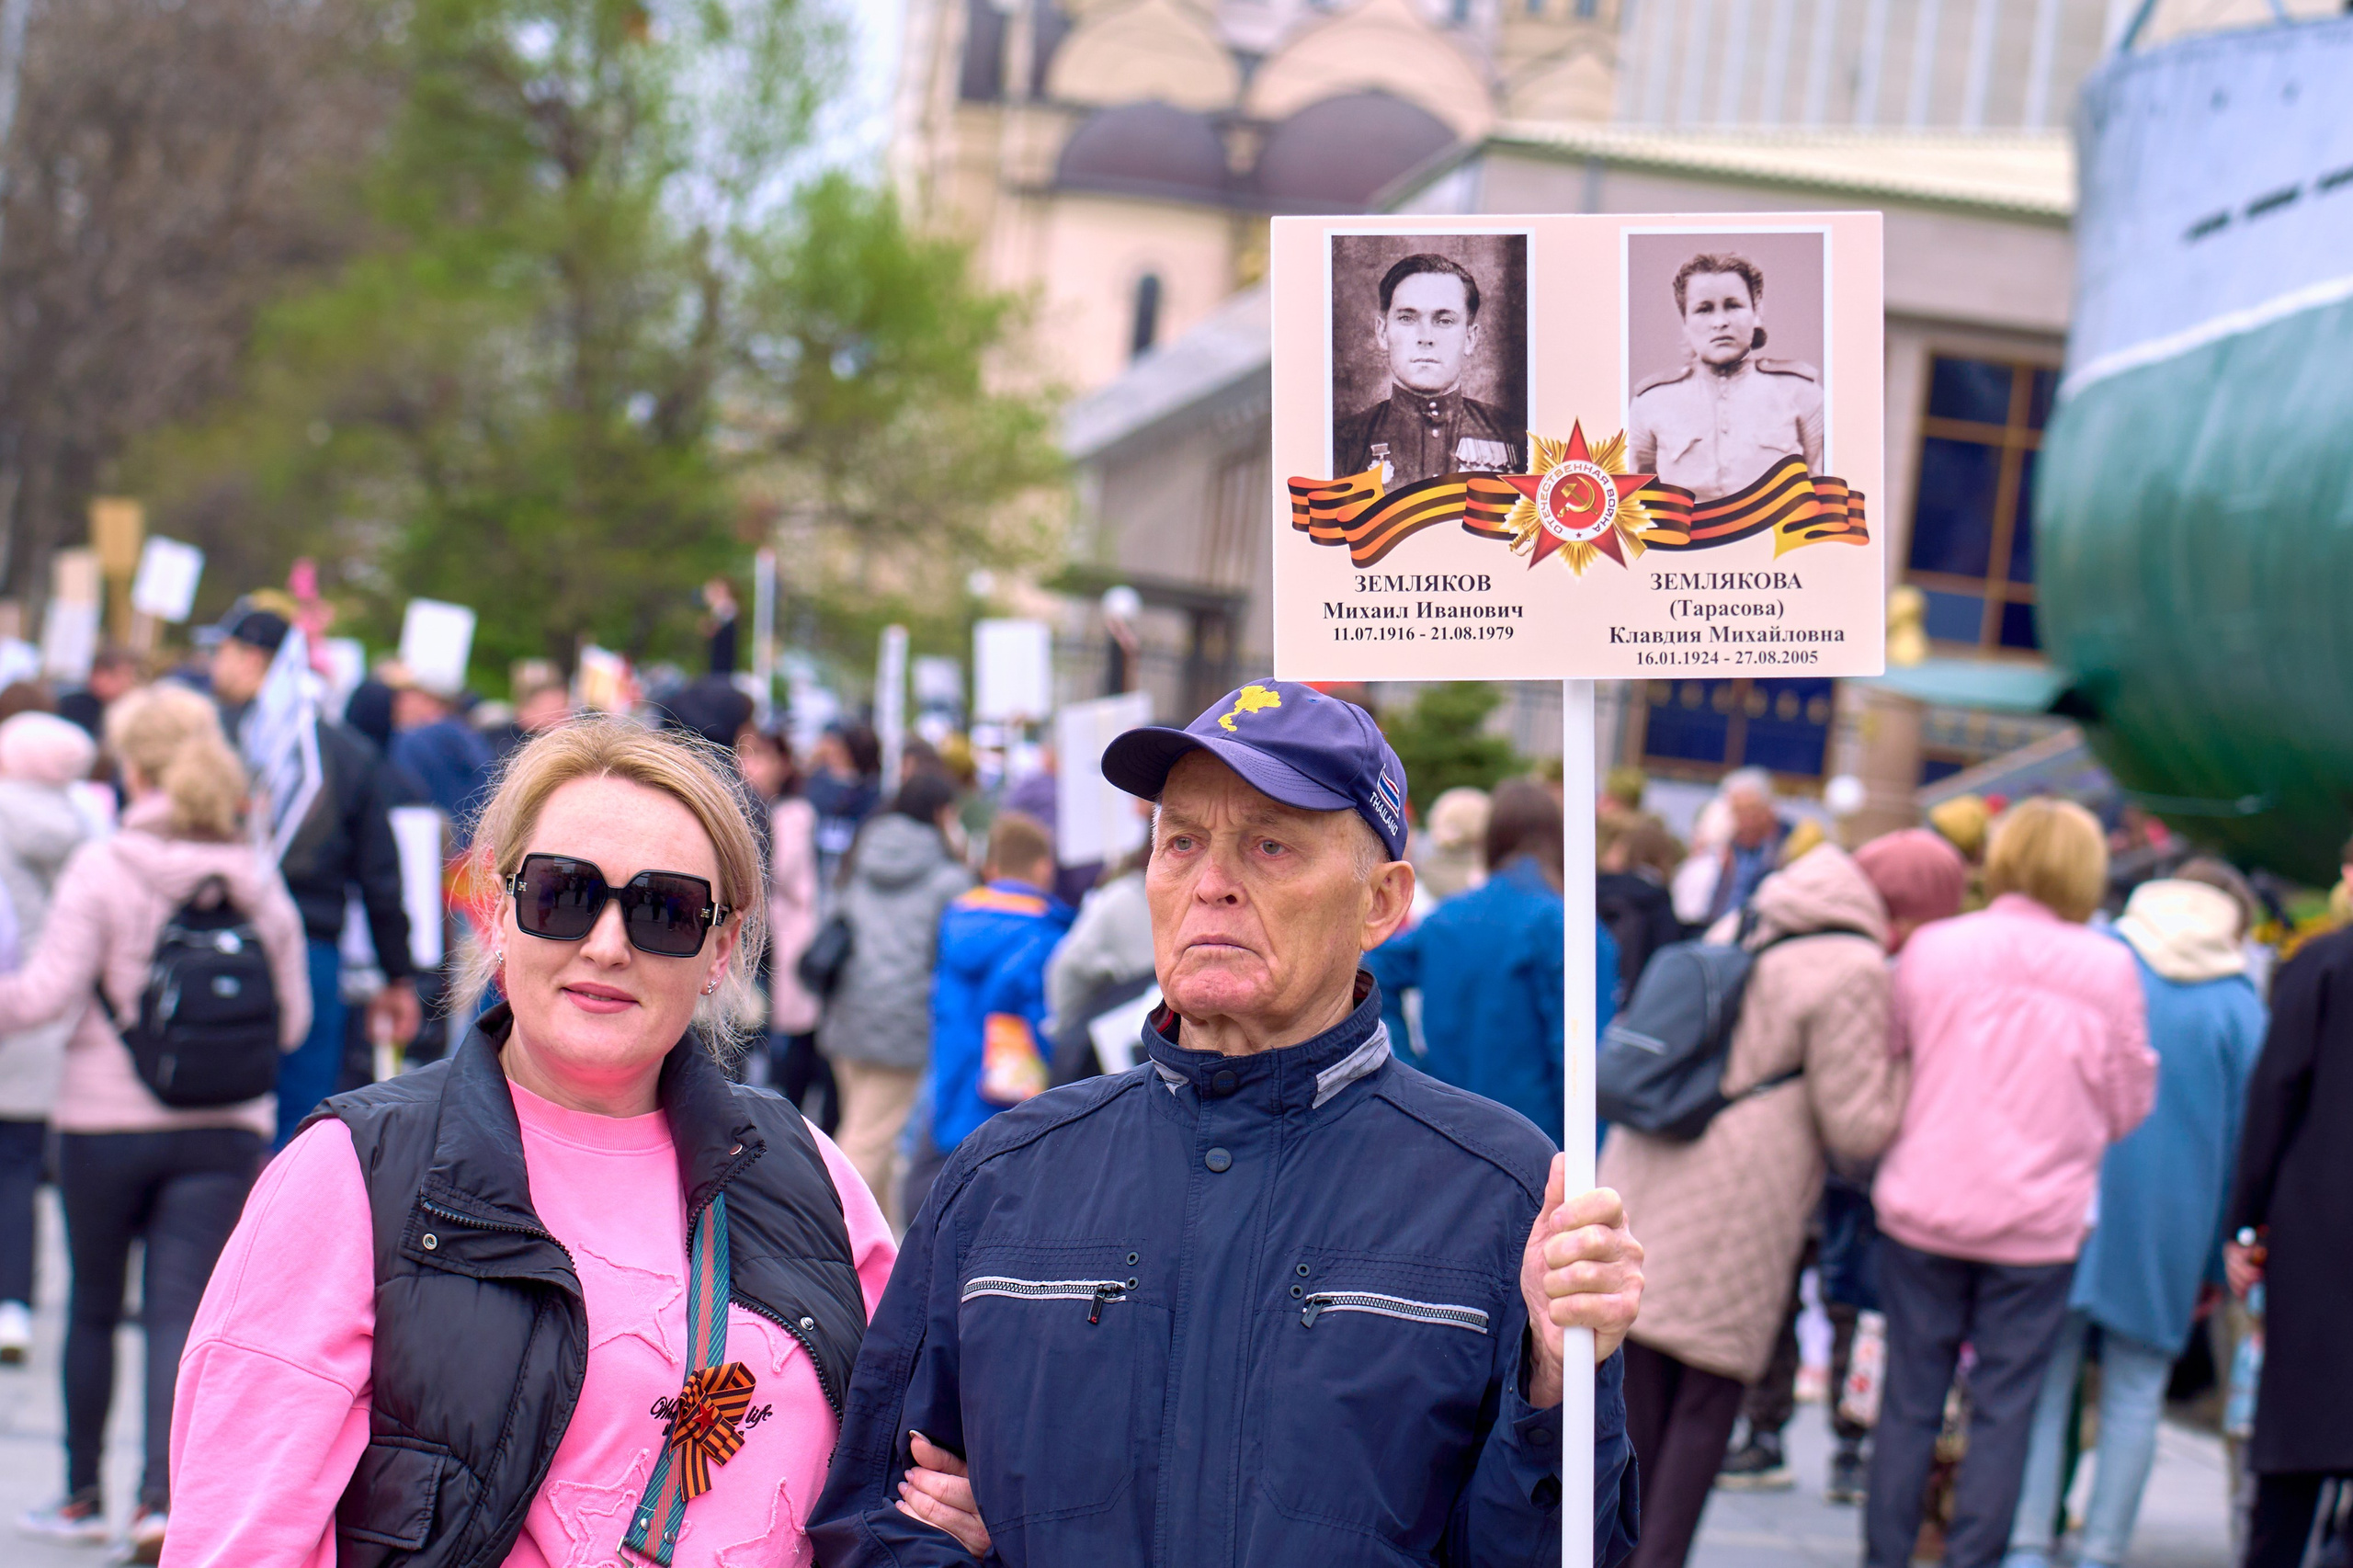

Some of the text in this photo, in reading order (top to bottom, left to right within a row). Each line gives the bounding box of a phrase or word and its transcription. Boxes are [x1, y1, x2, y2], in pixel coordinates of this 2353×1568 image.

[1540, 463, 1609, 534] ОТЕЧЕСТВЕННАЯ
[1355, 574, 1492, 593] ЗЕМЛЯКОВ
[1651, 572, 1802, 591] ЗЕМЛЯКОВА
[1324, 601, 1523, 619] Михаил Иванович
[1669, 599, 1784, 620] (Тарасова)
[1334, 626, 1415, 641] 11.07.1916
[1431, 626, 1514, 641] 21.08.1979
[1609, 625, 1845, 644] Клавдия Михайловна
[1637, 651, 1719, 665] 16.01.1924
[1735, 650, 1818, 665] 27.08.2005
[1370, 791, 1399, 836] THAILAND
